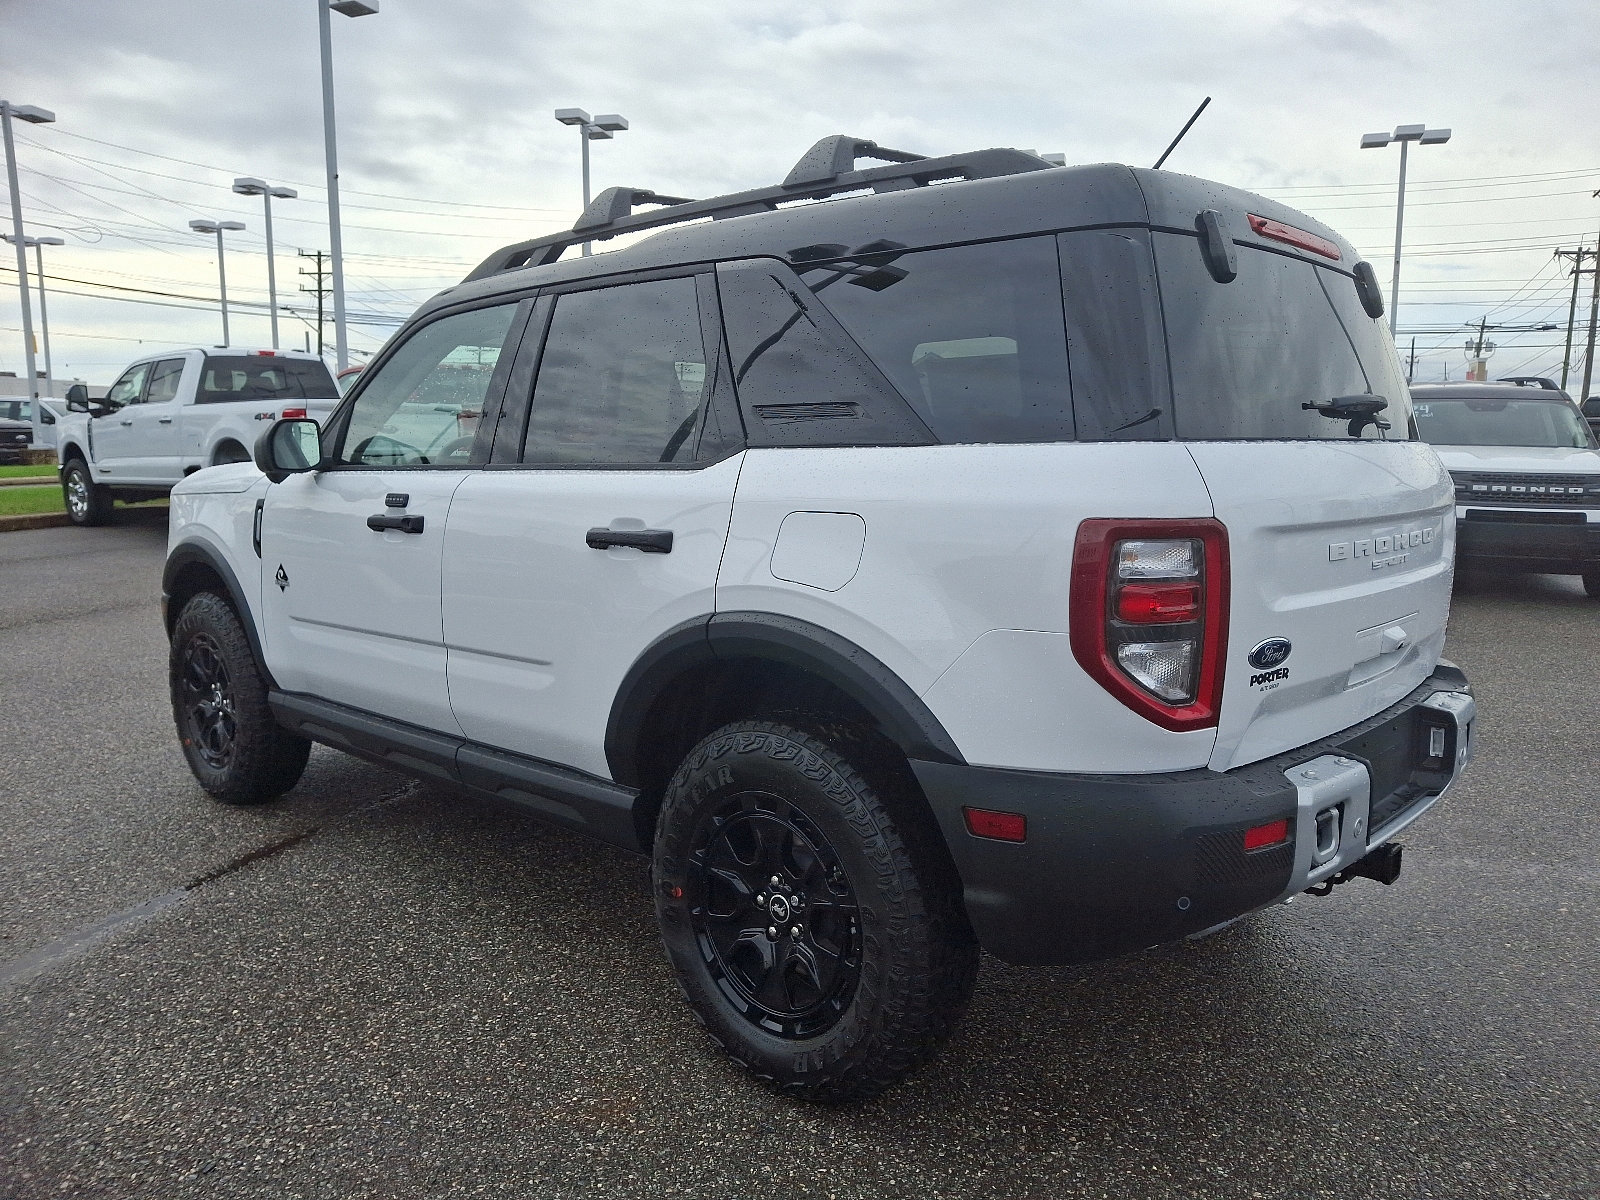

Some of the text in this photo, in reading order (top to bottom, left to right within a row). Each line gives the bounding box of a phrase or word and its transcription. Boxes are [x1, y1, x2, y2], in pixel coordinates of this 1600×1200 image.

[1472, 484, 1584, 494] BRONCO
[1329, 527, 1434, 561] BRONCO
[1249, 667, 1290, 687] PORTER
